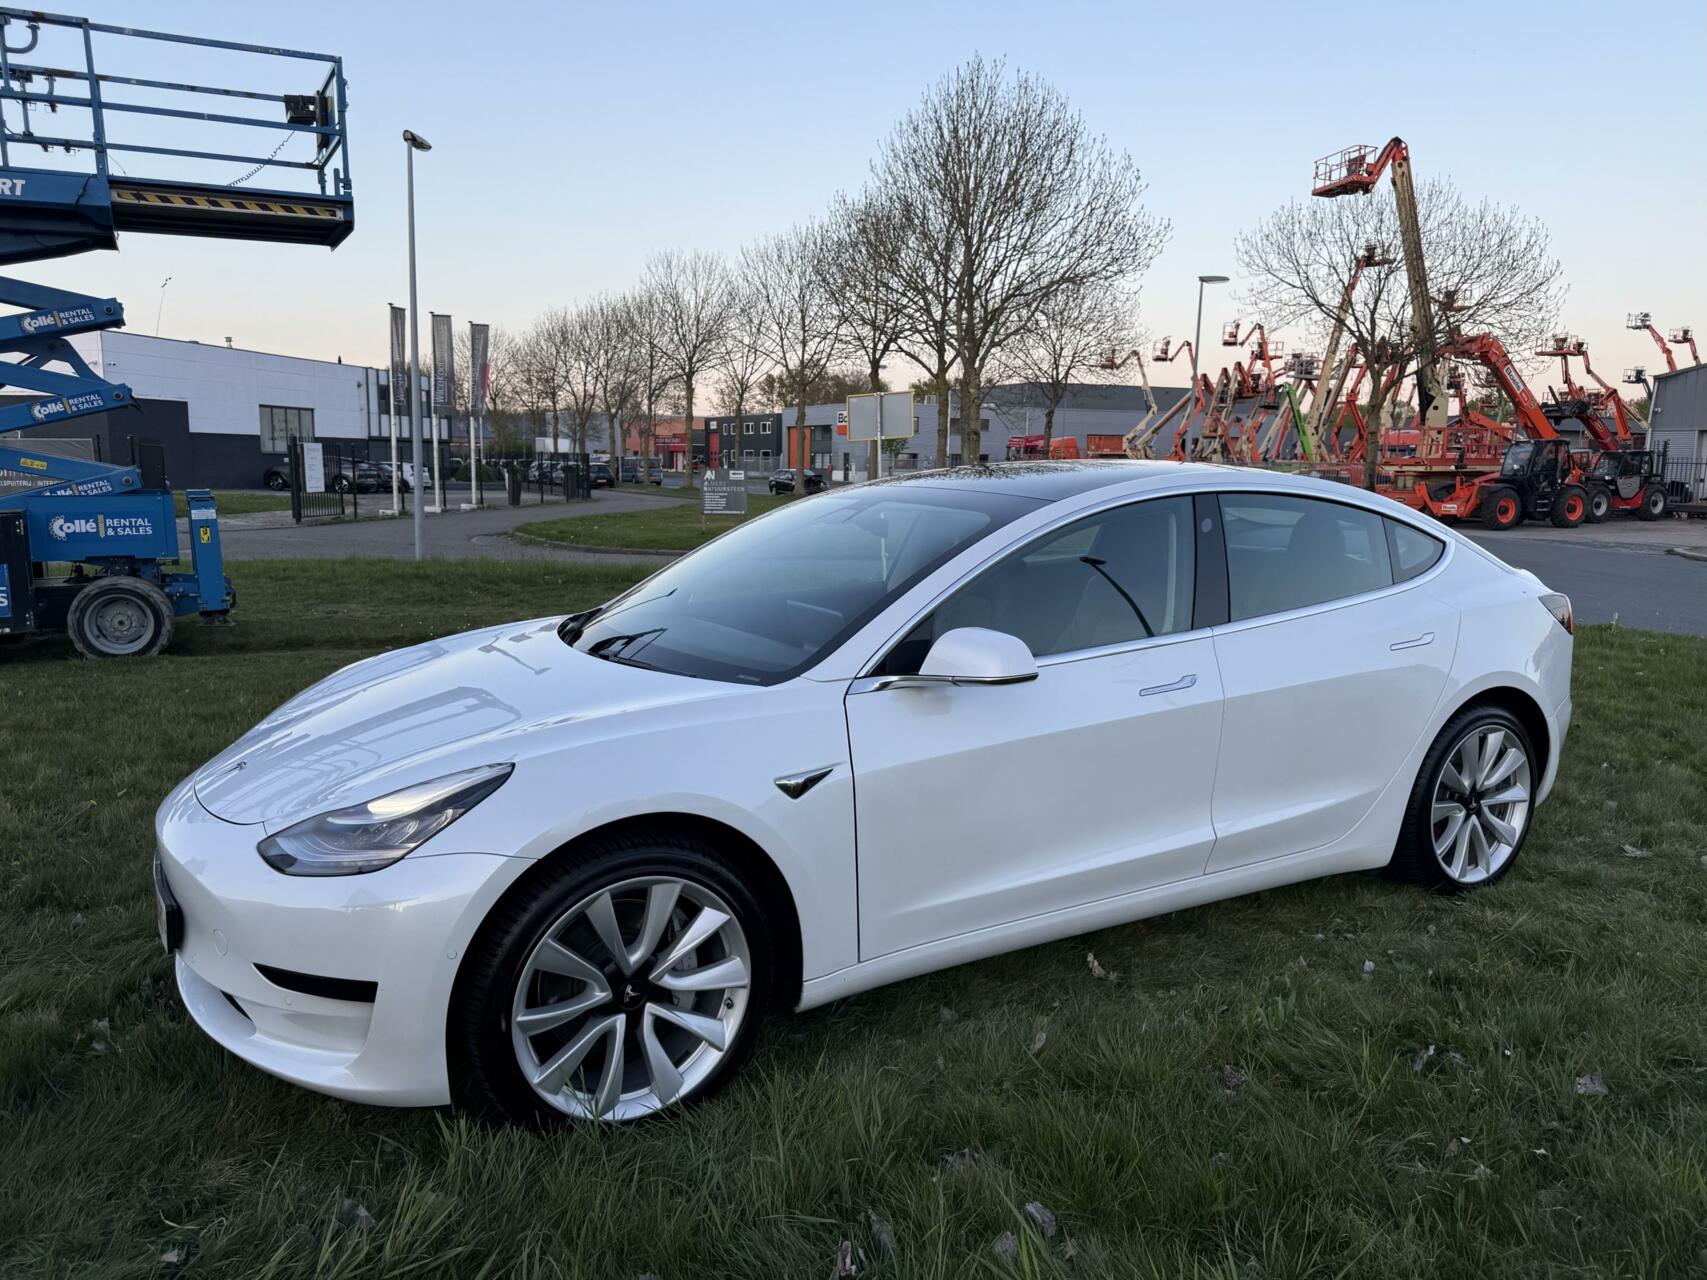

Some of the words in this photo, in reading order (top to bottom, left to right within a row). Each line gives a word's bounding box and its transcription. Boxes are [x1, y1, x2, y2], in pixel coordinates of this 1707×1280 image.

[60, 308, 93, 318] RENTAL
[23, 314, 55, 331] Collé
[70, 314, 95, 324] SALES
[68, 394, 101, 404] RENTAL
[33, 401, 64, 418] Collé
[78, 400, 104, 409] SALES
[78, 479, 110, 491] RENTAL
[88, 486, 113, 495] SALES
[106, 518, 152, 527] RENTAL
[52, 519, 97, 537] Collé
[106, 528, 115, 536] &
[117, 527, 153, 536] SALES
